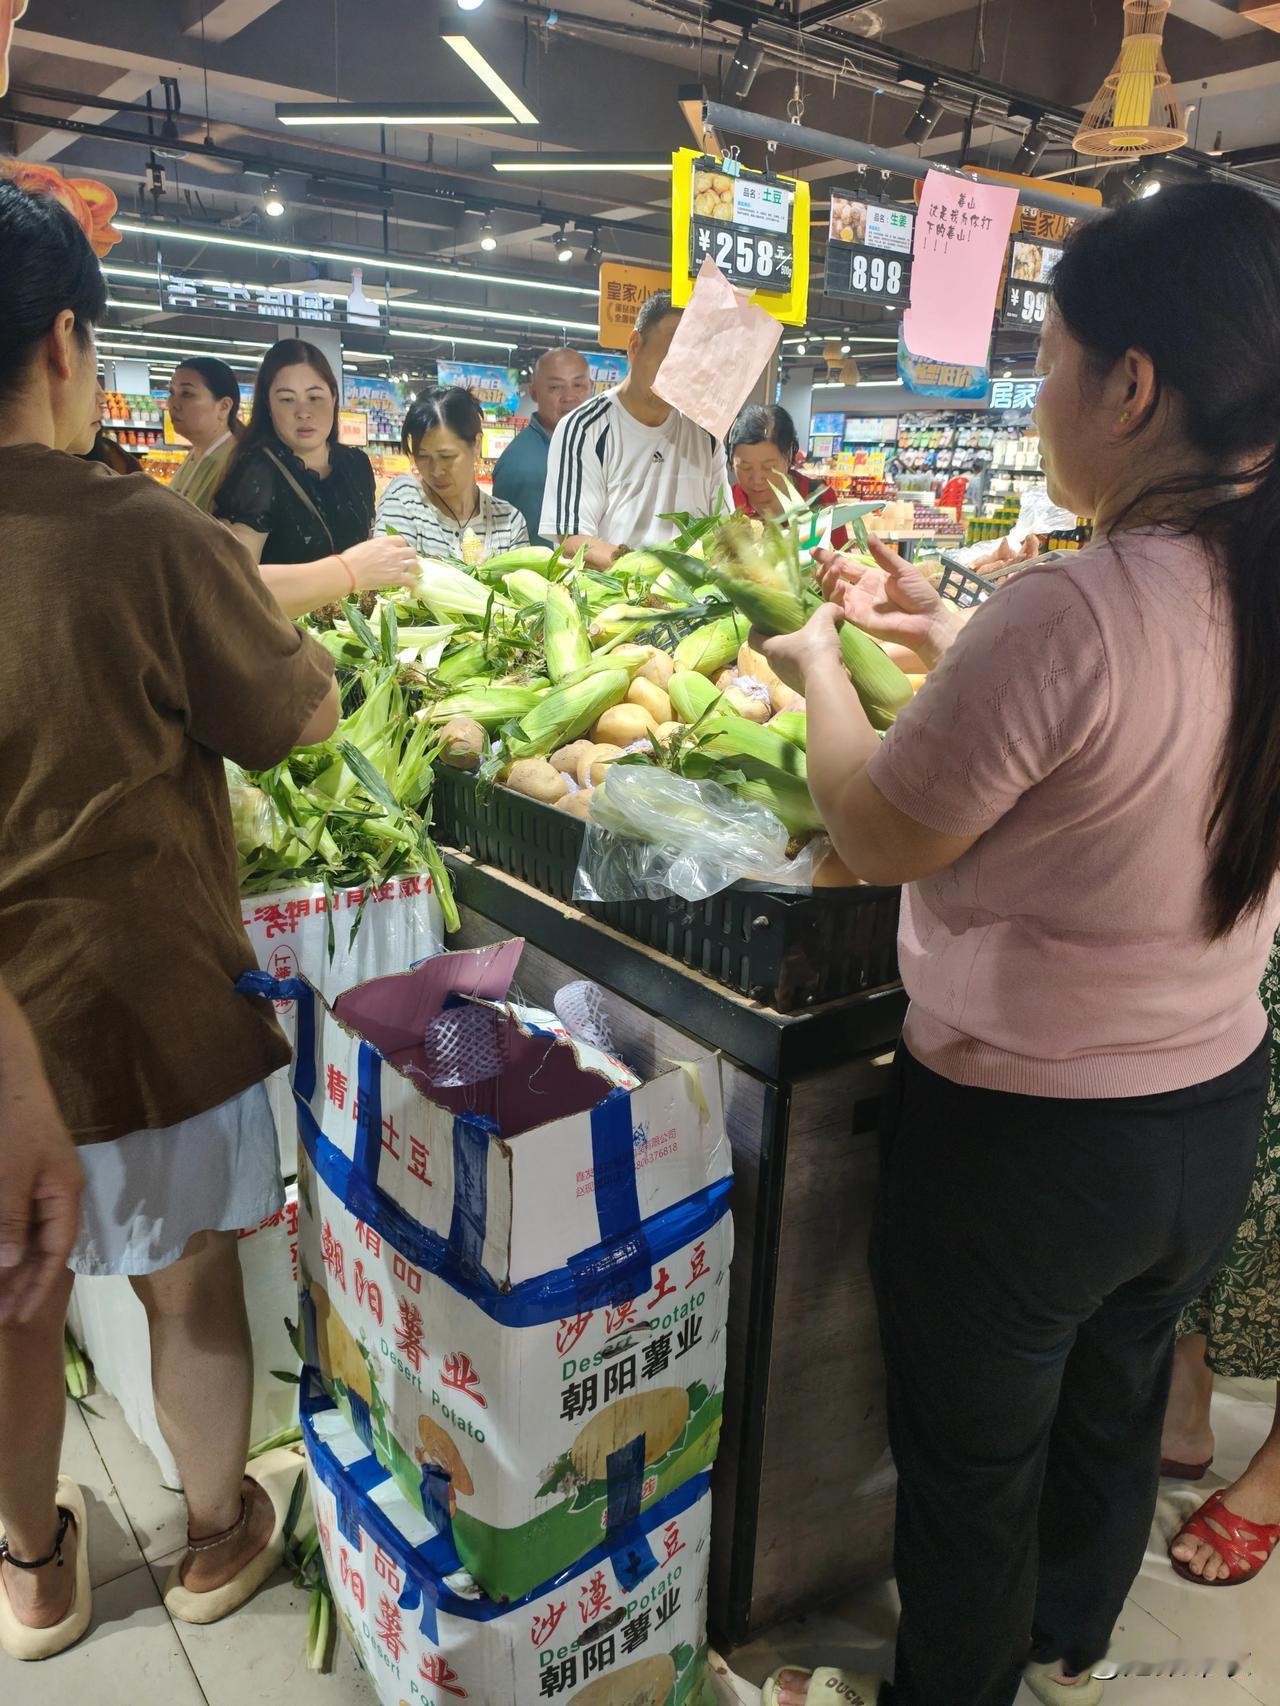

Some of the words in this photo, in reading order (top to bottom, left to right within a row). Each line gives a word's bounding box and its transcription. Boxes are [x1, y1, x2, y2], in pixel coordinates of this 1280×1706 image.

[380, 1336, 422, 1394] Desert
[432, 1388, 486, 1444] Potato
[560, 1313, 703, 1421] 朝阳薯业
[538, 1586, 681, 1699] 朝阳薯业
